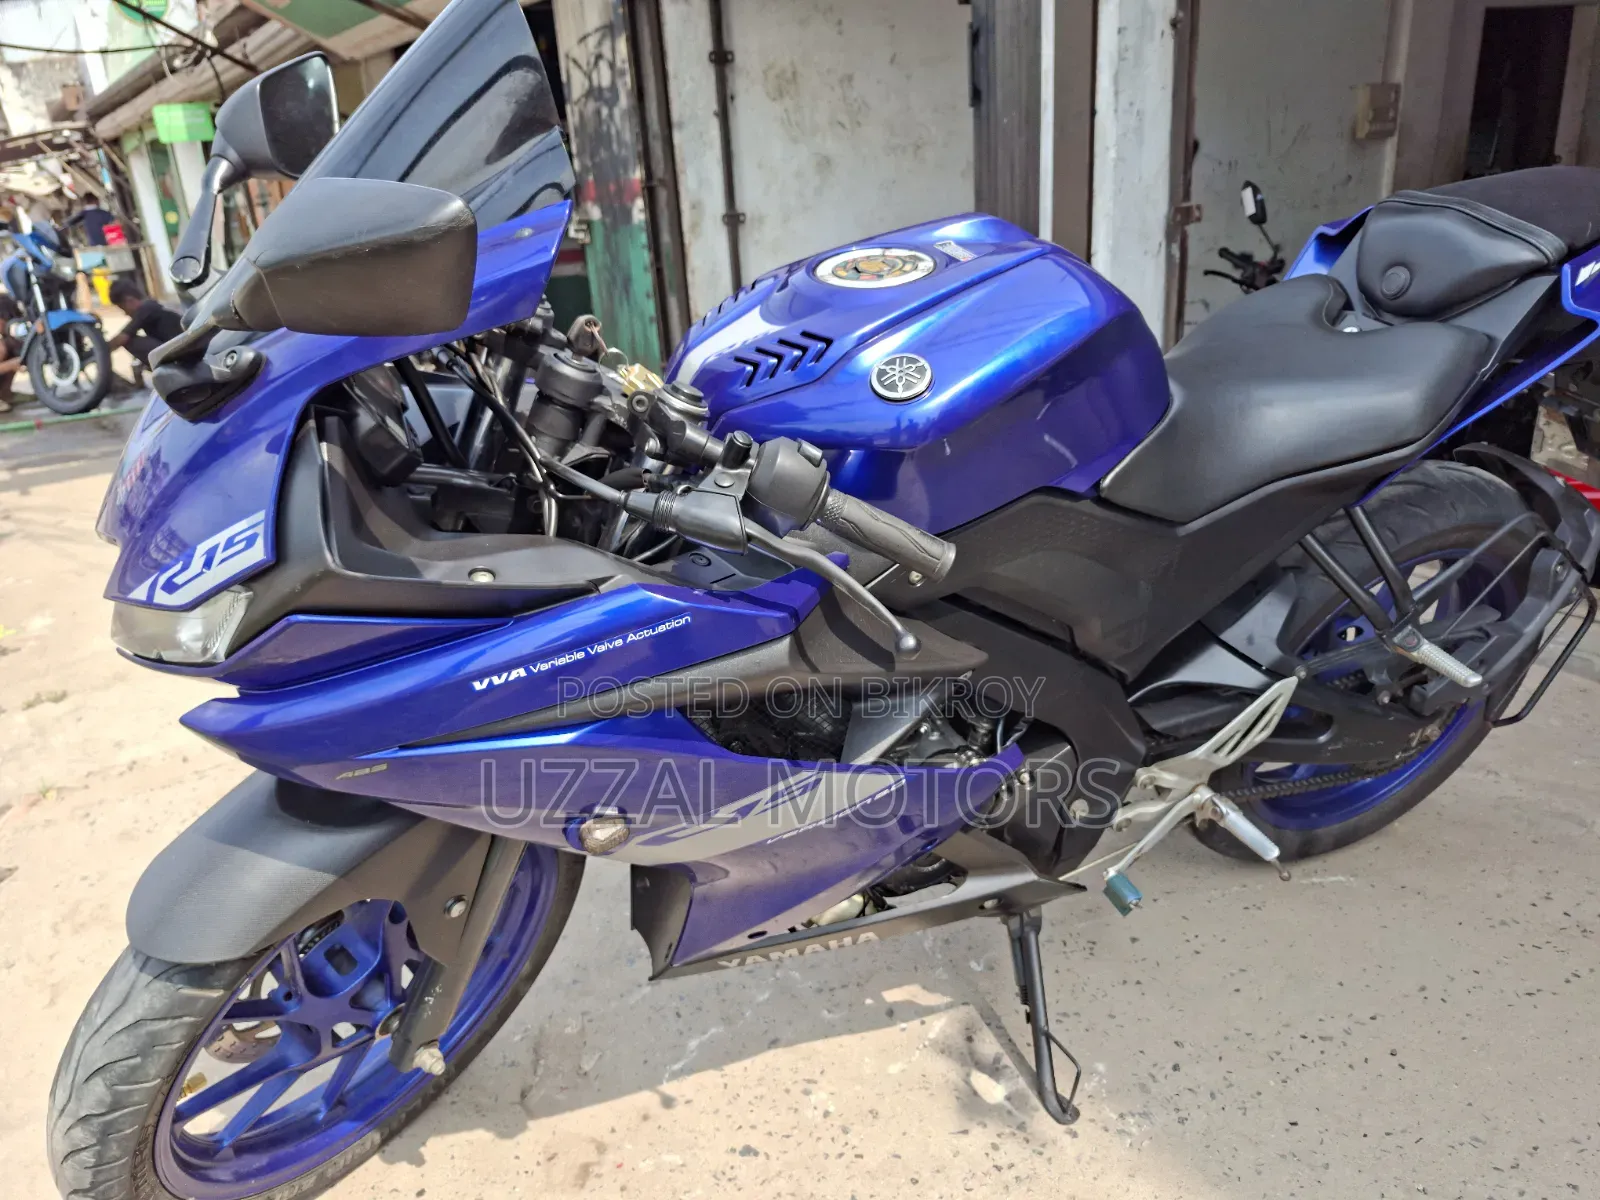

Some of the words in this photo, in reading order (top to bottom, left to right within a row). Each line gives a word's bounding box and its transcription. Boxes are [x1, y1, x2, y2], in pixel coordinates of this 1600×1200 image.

[471, 667, 528, 691] VVA
[529, 651, 586, 673] Variable
[587, 638, 624, 655] Valve
[626, 615, 692, 643] Actuation
[716, 931, 881, 969] YAMAHA
